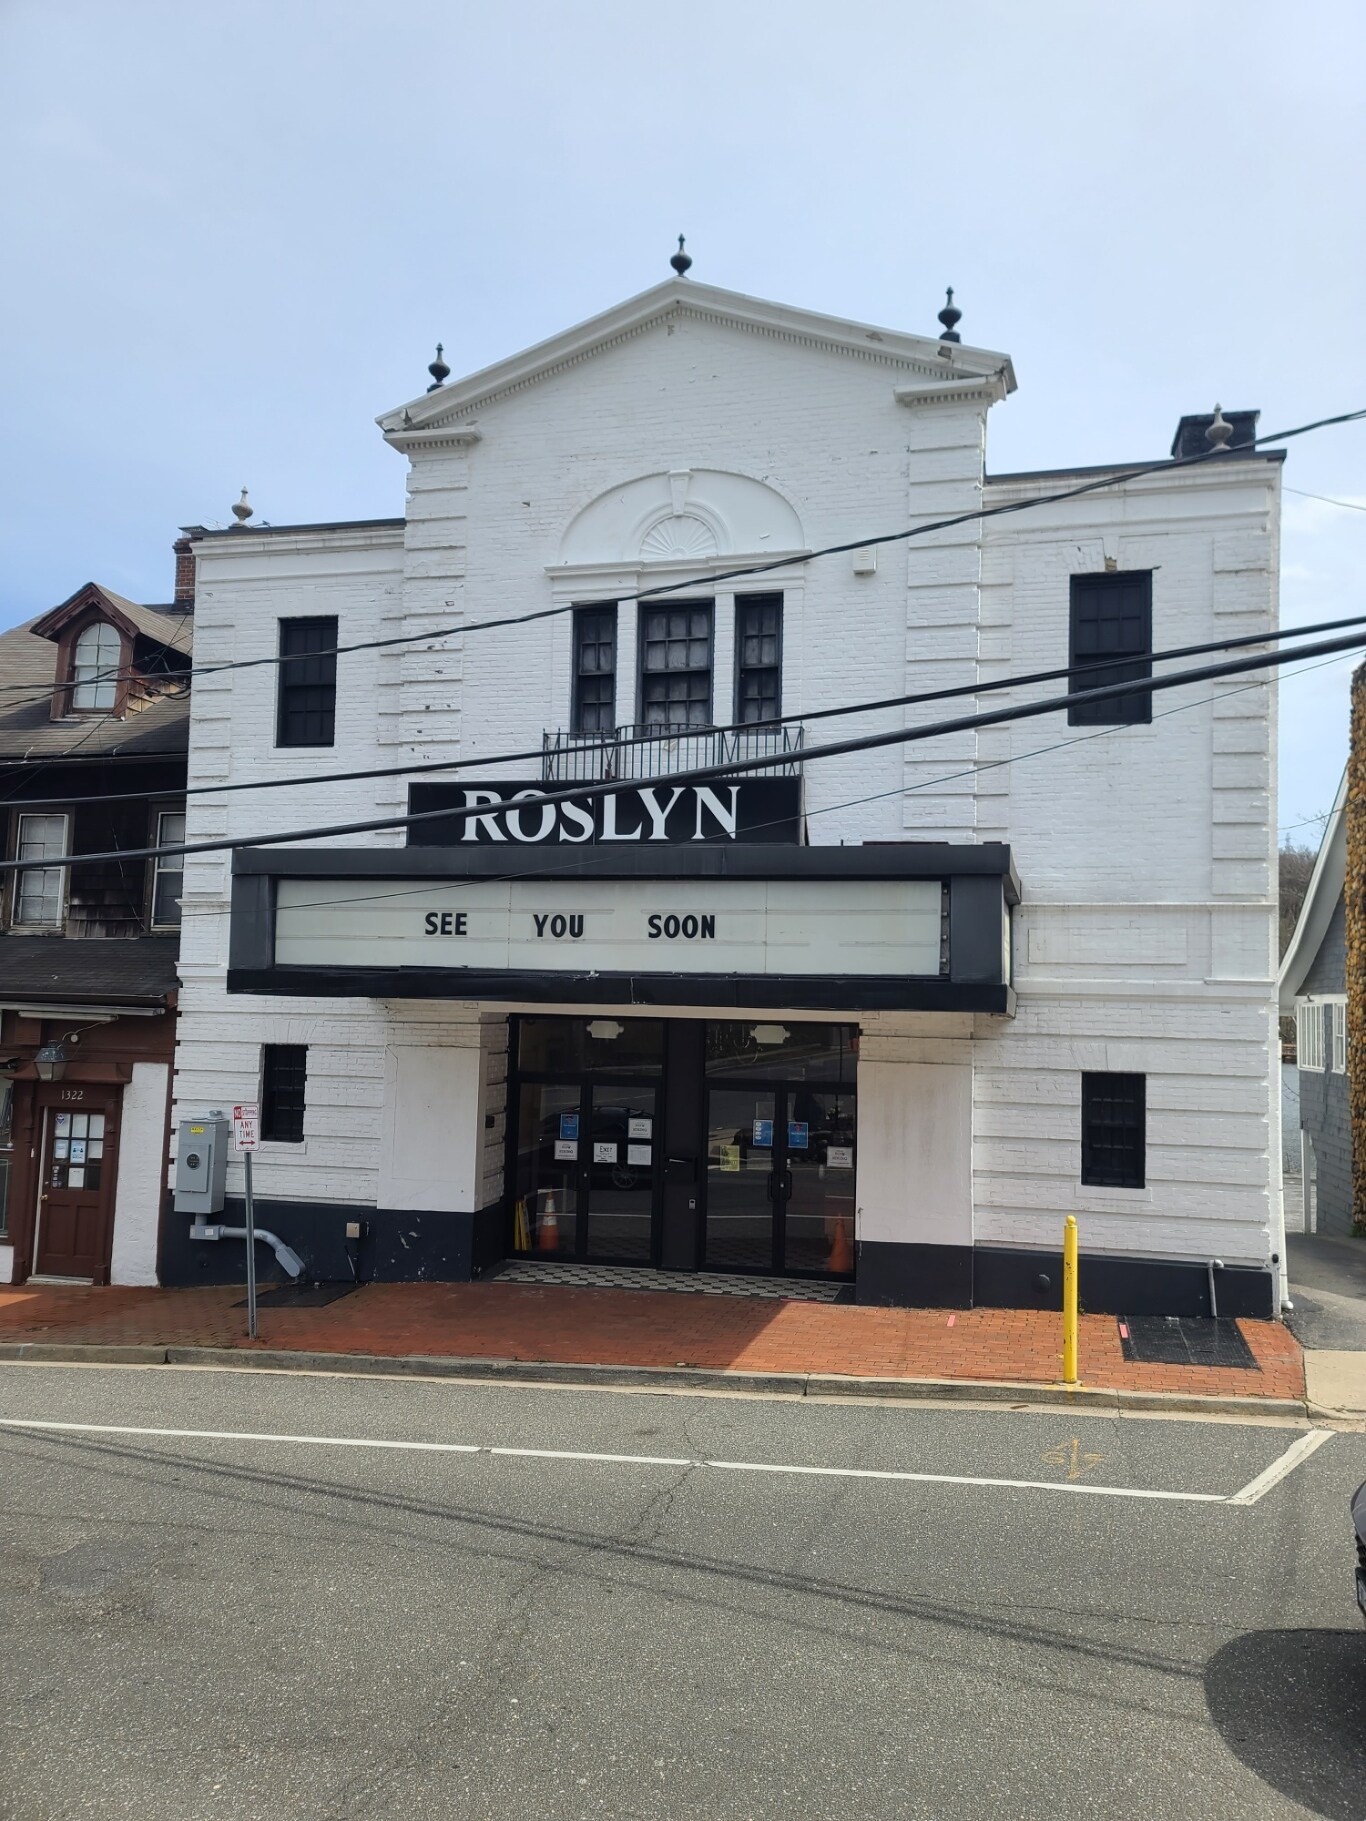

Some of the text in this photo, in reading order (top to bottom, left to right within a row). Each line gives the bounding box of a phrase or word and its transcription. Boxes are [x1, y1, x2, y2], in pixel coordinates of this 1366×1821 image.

[461, 786, 743, 843] ROSLYN
[425, 912, 716, 939] SEE YOU SOON
[61, 1090, 84, 1100] 1322
[240, 1121, 252, 1129] ANY
[239, 1130, 254, 1138] TIME
